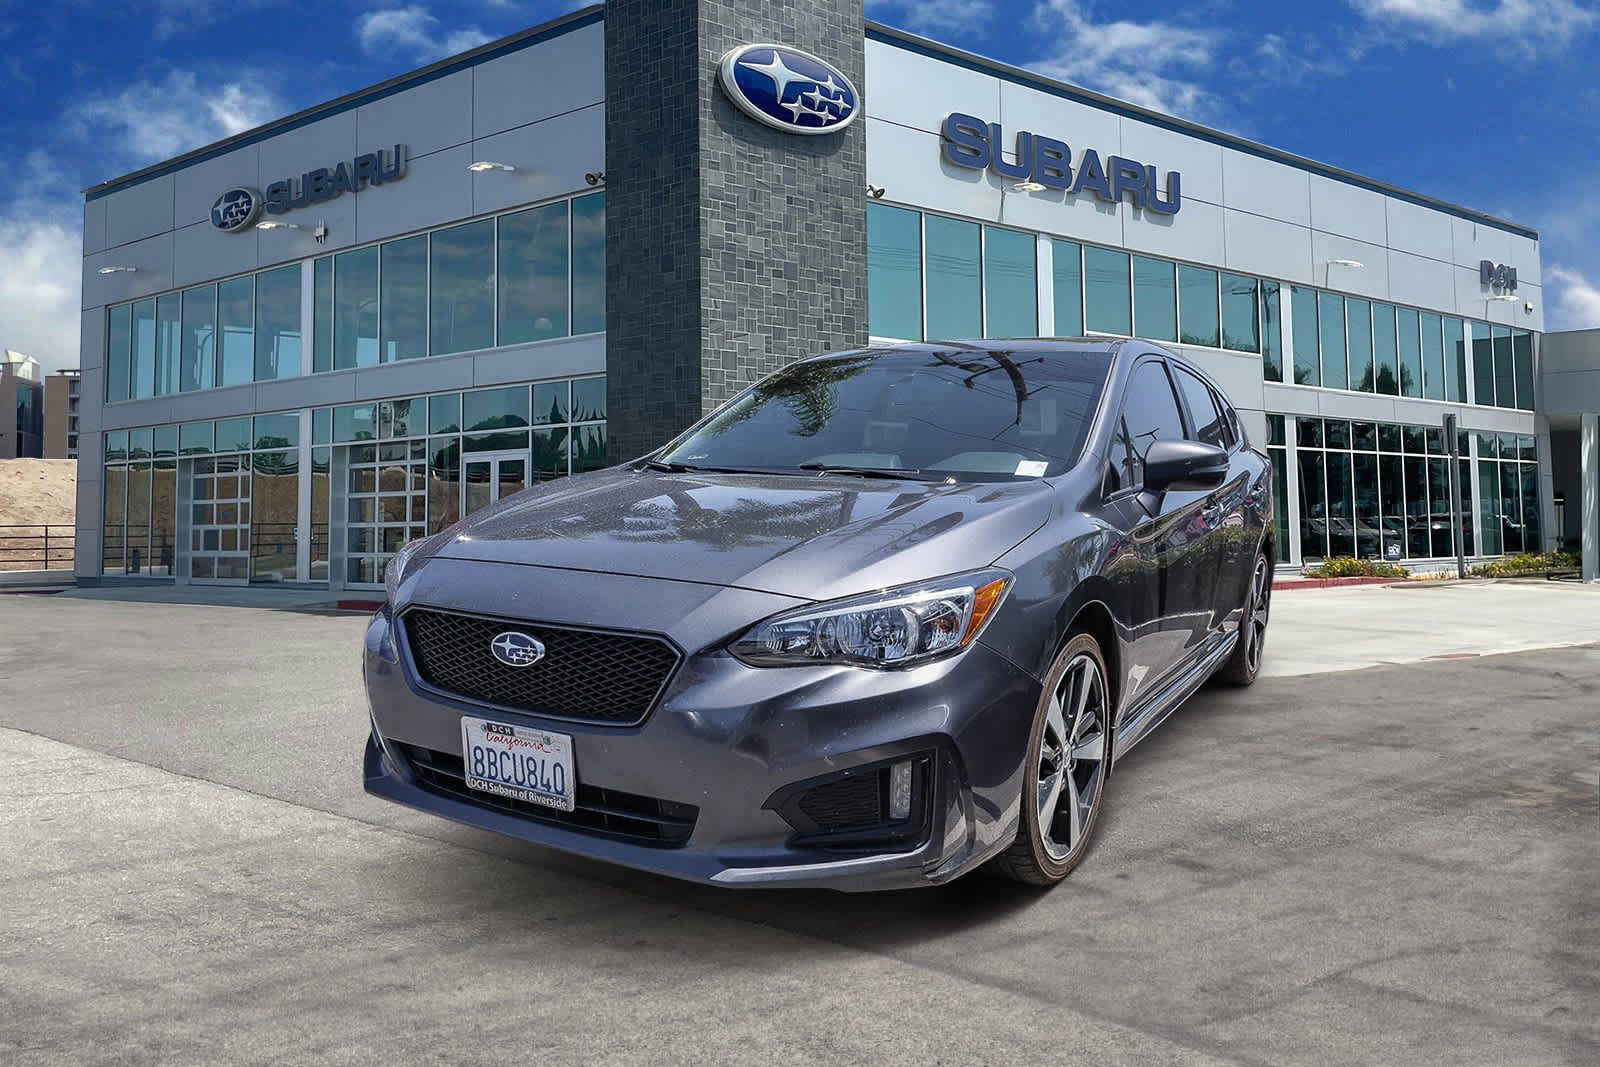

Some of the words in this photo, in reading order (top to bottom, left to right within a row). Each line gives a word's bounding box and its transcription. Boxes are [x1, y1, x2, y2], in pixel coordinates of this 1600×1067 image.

[266, 144, 407, 215] SUBARU
[941, 112, 1181, 215] SUBARU
[486, 732, 551, 753] California
[491, 724, 512, 734] DCH
[473, 745, 566, 796] 8BCU840
[470, 778, 488, 790] DCH
[488, 782, 518, 797] Subaru
[519, 790, 529, 801] of
[528, 791, 567, 809] Riverside
